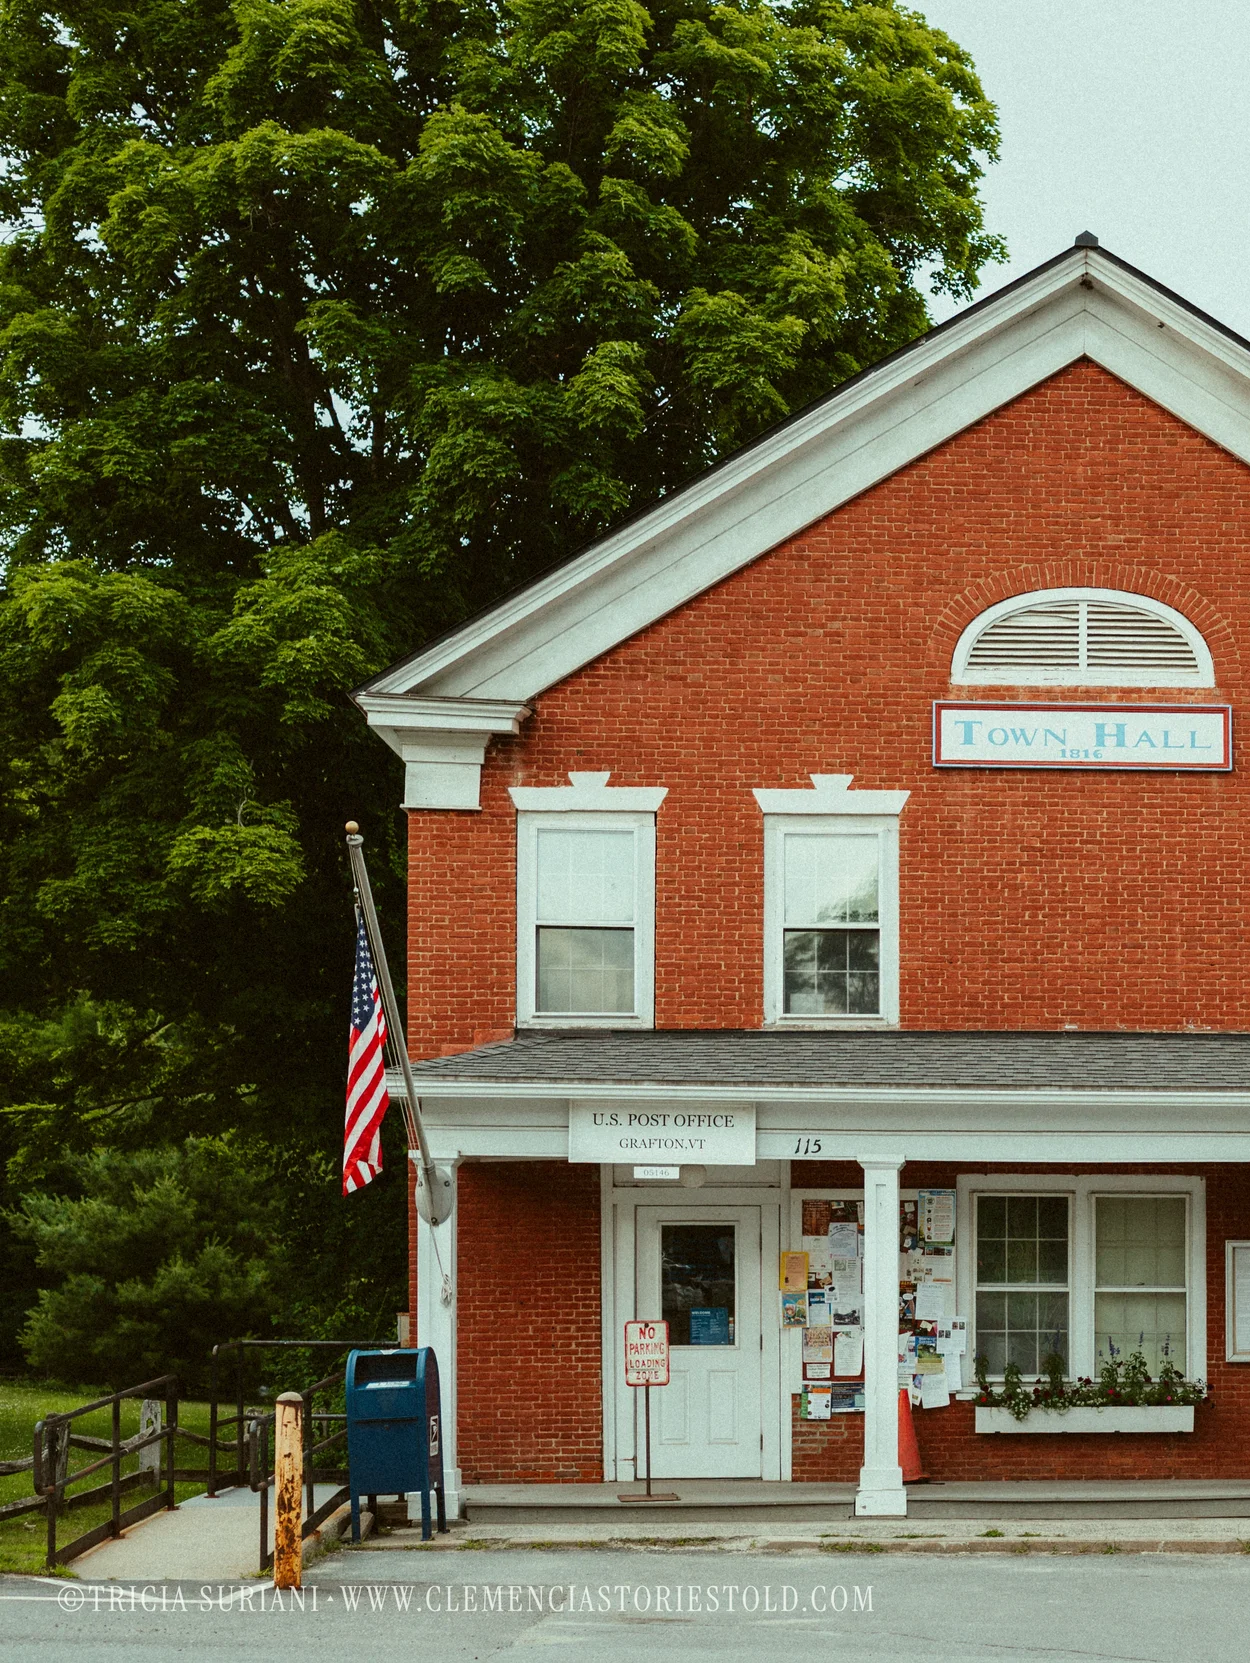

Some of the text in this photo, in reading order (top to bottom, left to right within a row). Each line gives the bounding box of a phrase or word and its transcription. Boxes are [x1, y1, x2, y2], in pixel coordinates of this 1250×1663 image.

[1059, 749, 1103, 759] 1816
[592, 1112, 734, 1128] U.S. POST OFFICE
[794, 1137, 822, 1155] 115
[643, 1168, 670, 1177] 05146
[638, 1326, 656, 1340] NO
[629, 1342, 665, 1355] PARKING
[629, 1358, 666, 1369] LOADING
[636, 1370, 659, 1380] ZONE
